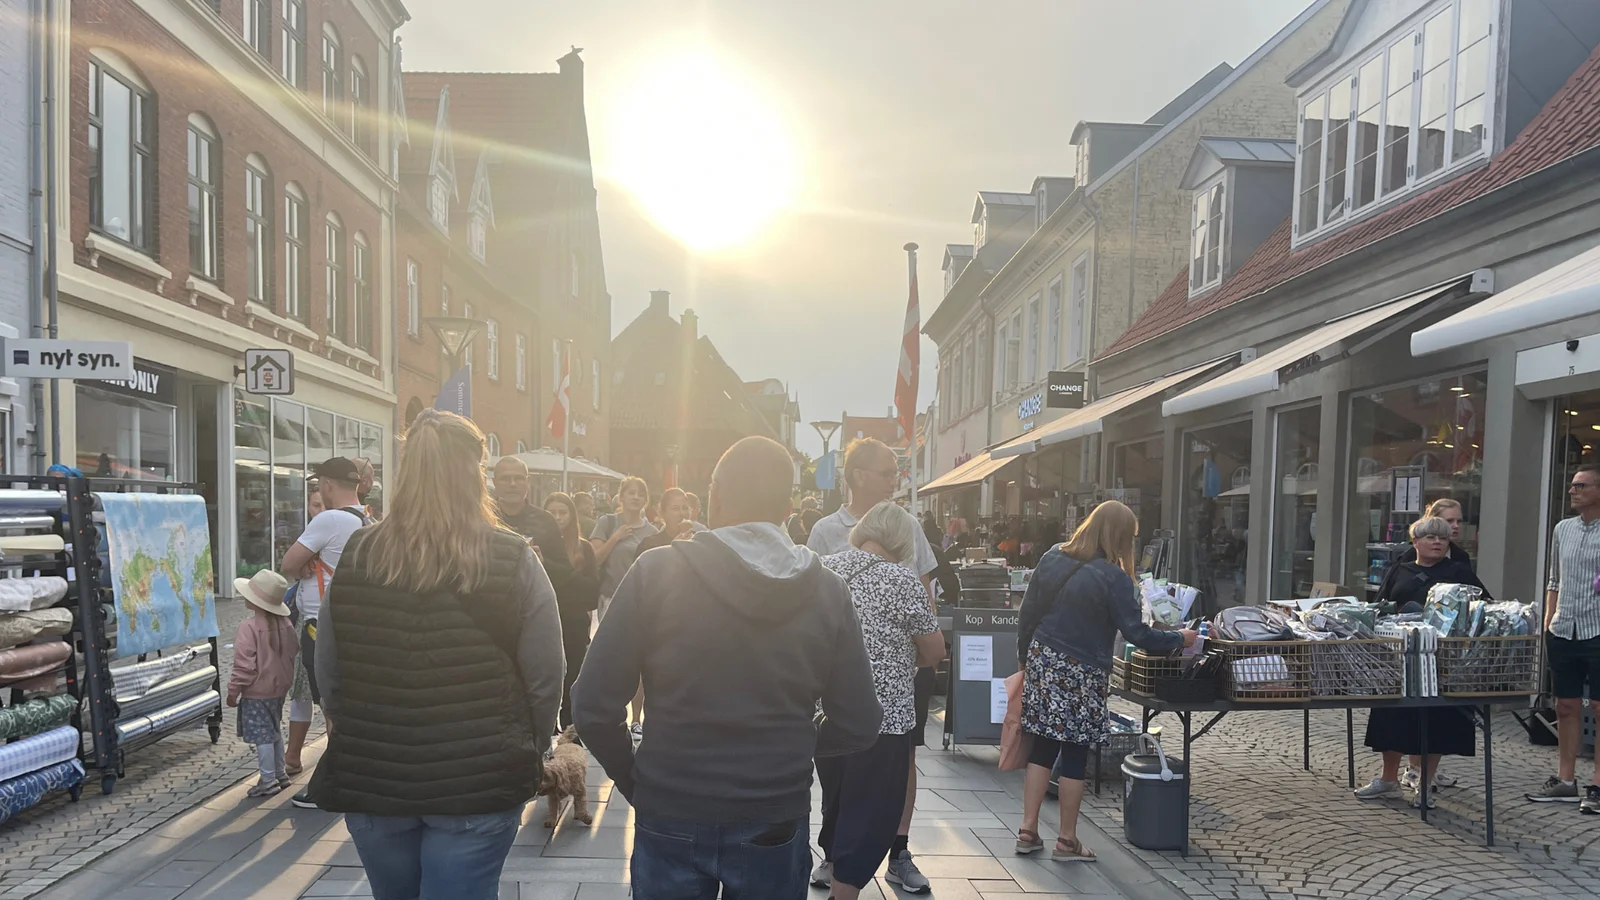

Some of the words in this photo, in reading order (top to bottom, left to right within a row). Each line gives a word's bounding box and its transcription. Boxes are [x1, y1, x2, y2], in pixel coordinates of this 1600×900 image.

[40, 349, 73, 370] nyt
[77, 352, 120, 371] syn.
[1568, 365, 1575, 375] 75
[128, 369, 160, 394] ONLY
[1049, 384, 1083, 392] CHANGE
[965, 614, 983, 625] Kop
[991, 615, 1019, 625] Kande
